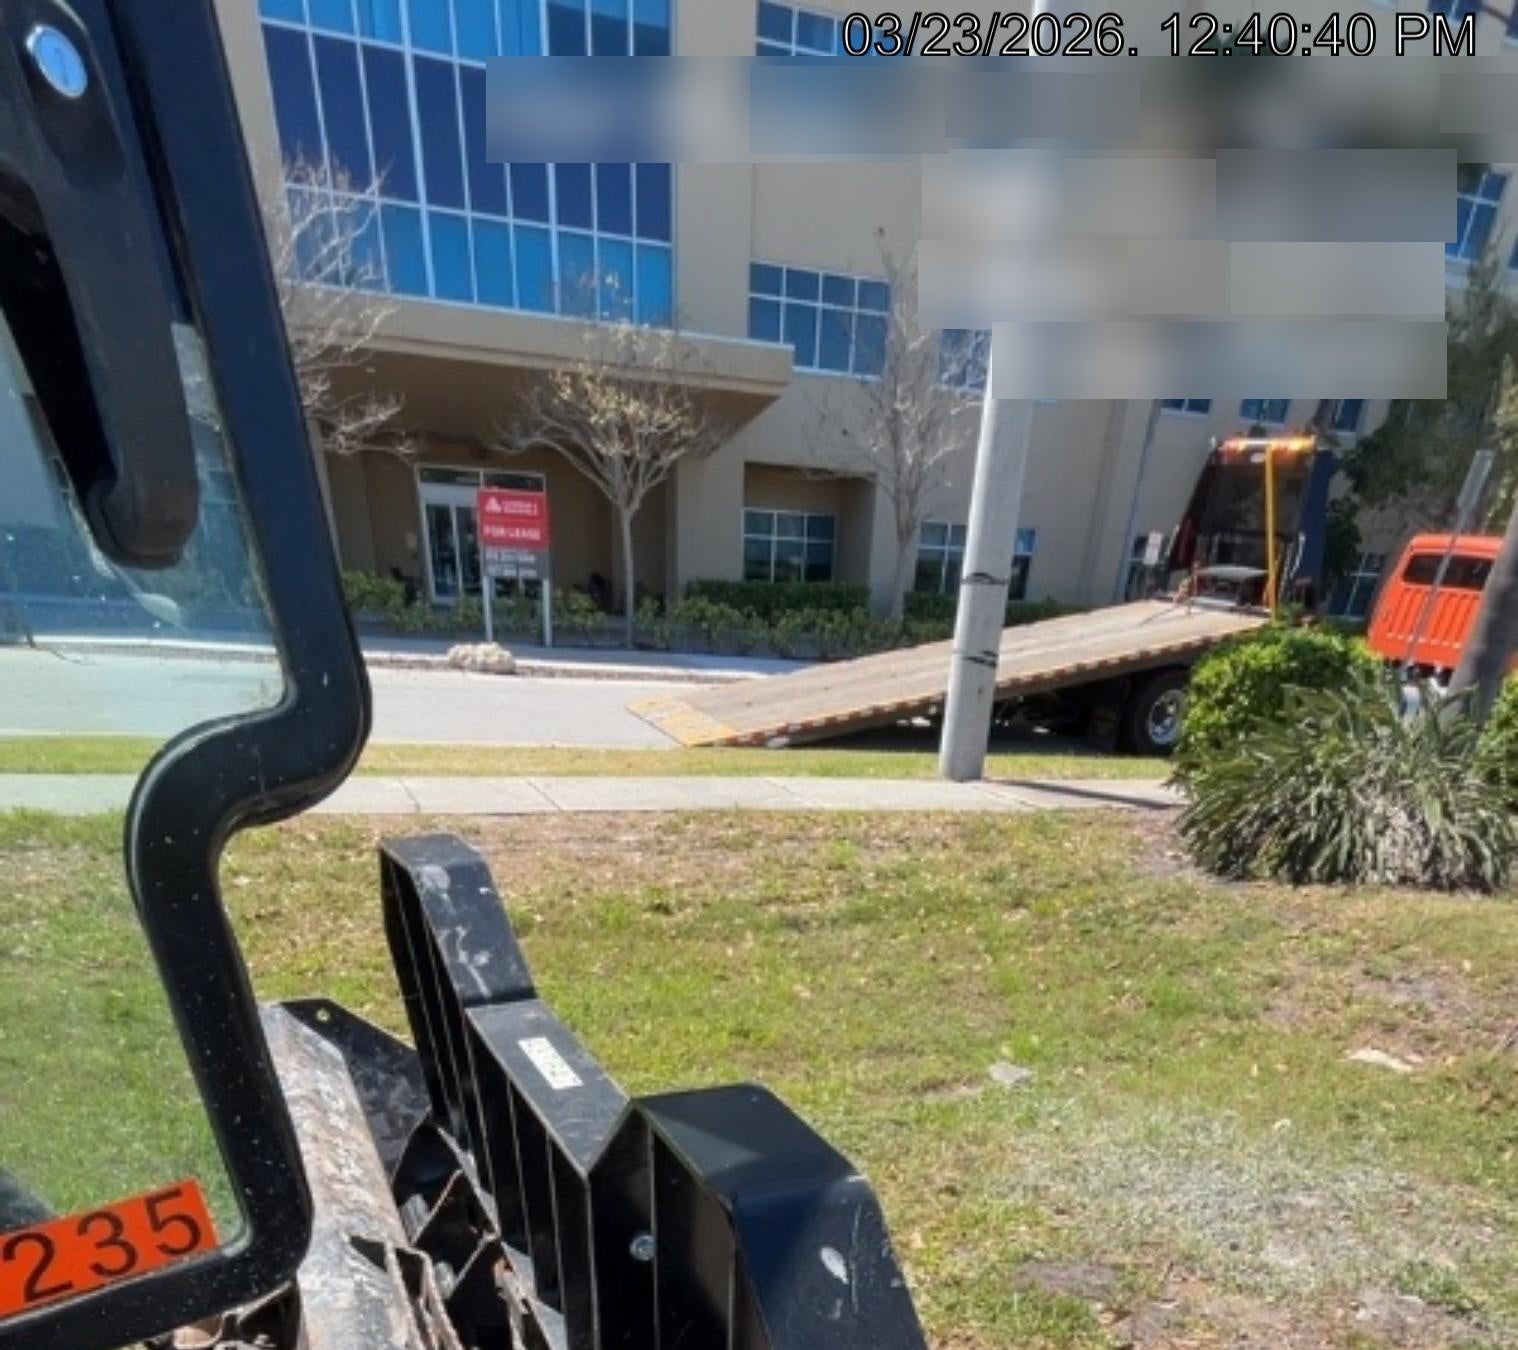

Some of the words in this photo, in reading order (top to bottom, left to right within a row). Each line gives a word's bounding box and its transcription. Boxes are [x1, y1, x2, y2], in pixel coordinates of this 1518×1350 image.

[482, 524, 505, 538] FOR
[509, 527, 541, 541] LEASE
[2, 1187, 202, 1303] 235
